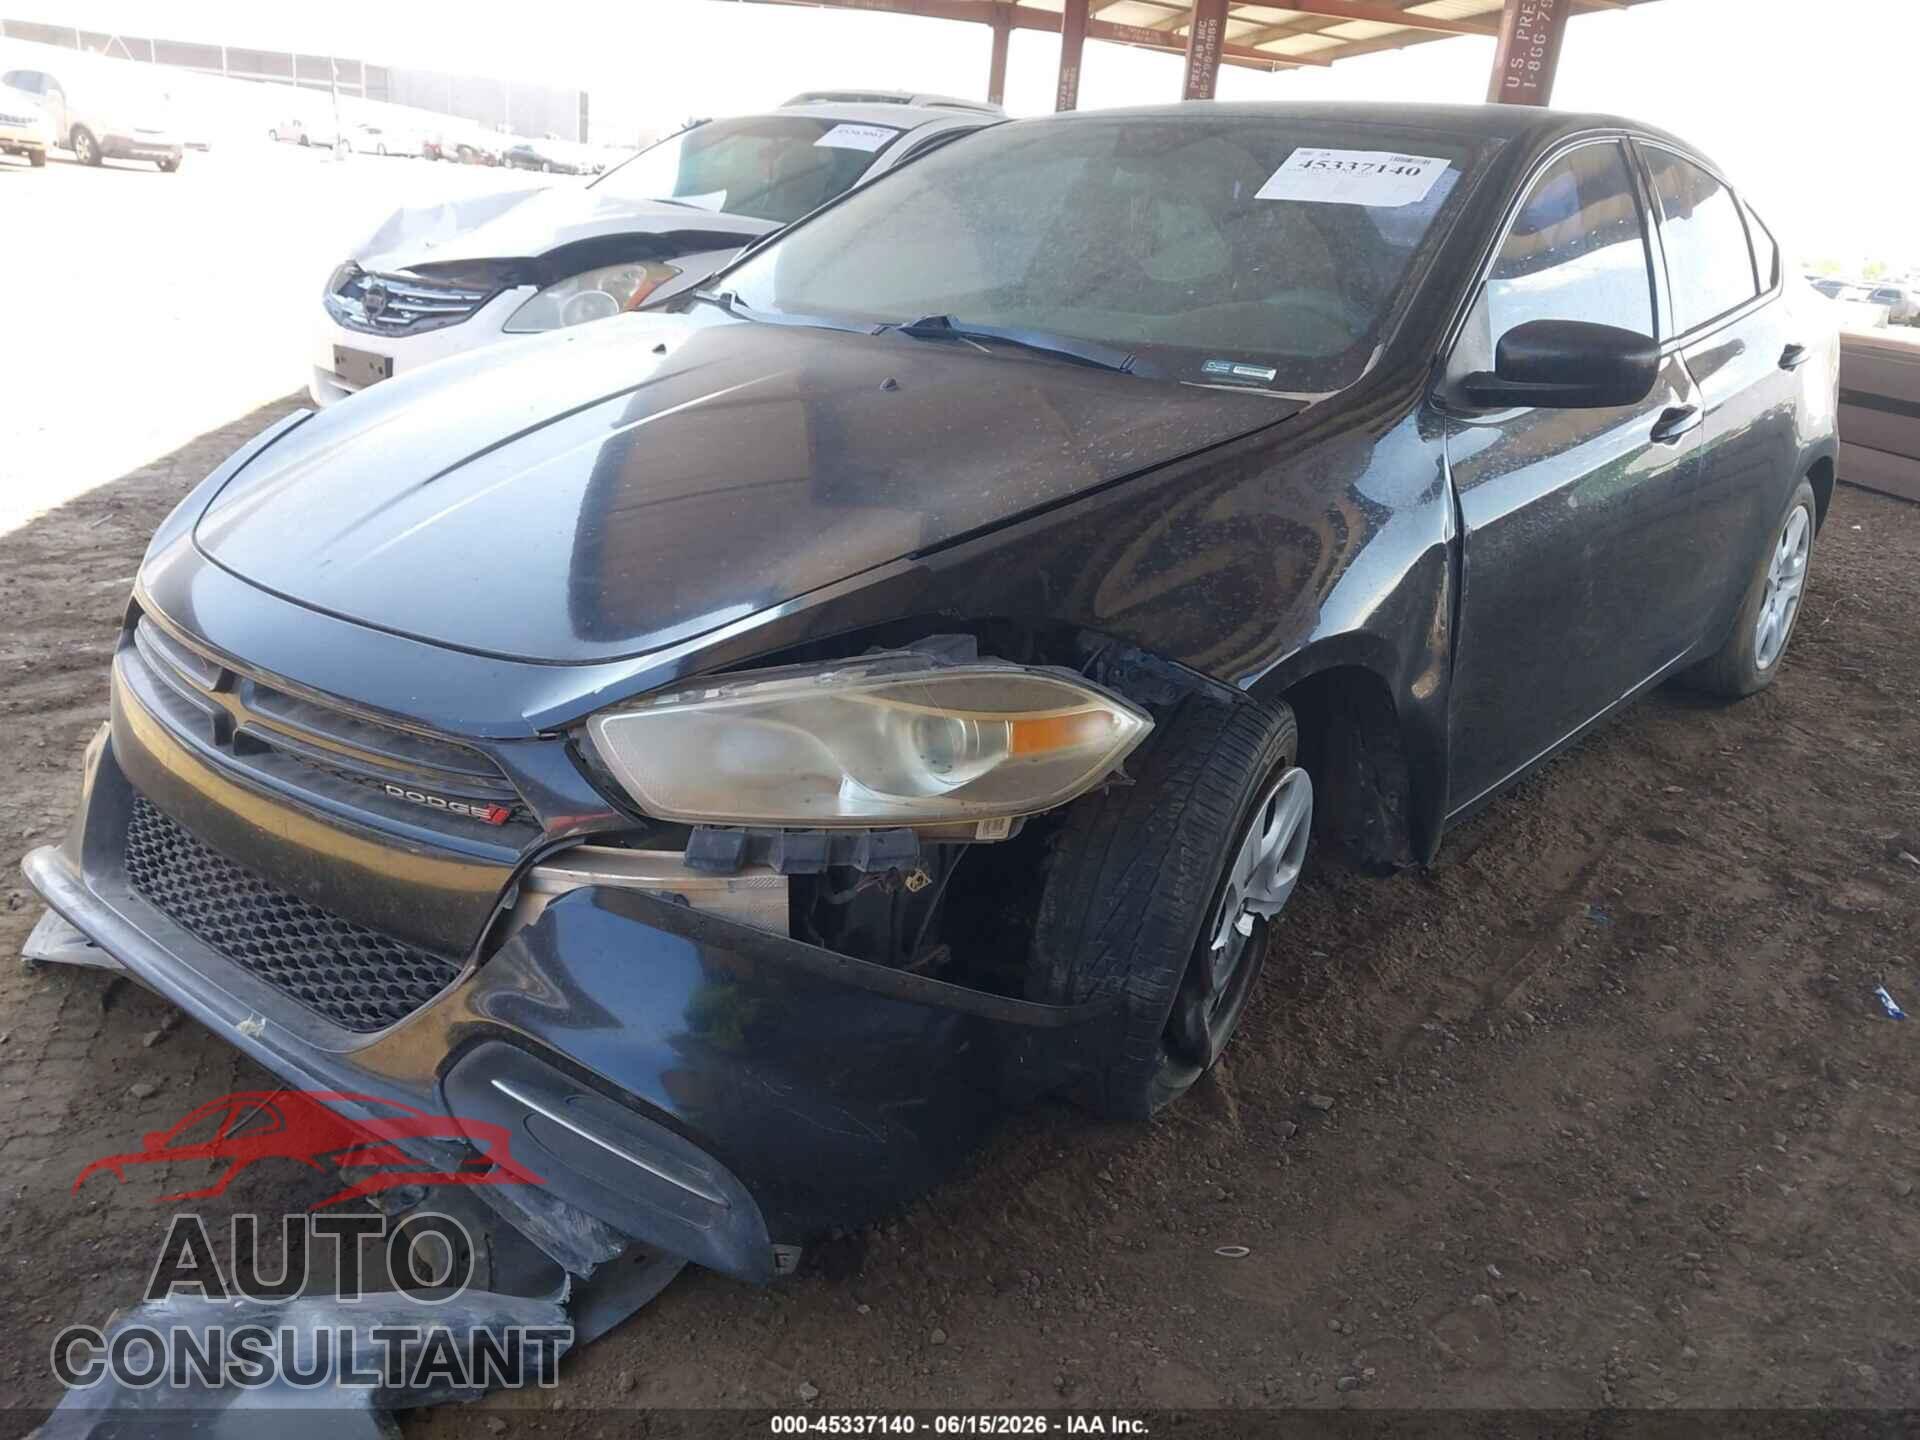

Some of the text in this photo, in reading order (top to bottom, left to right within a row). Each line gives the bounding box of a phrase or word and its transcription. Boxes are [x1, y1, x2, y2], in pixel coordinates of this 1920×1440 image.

[1505, 0, 1538, 88] U.S. PRE
[1297, 159, 1421, 176] 45337140
[384, 784, 491, 820] DODGE
